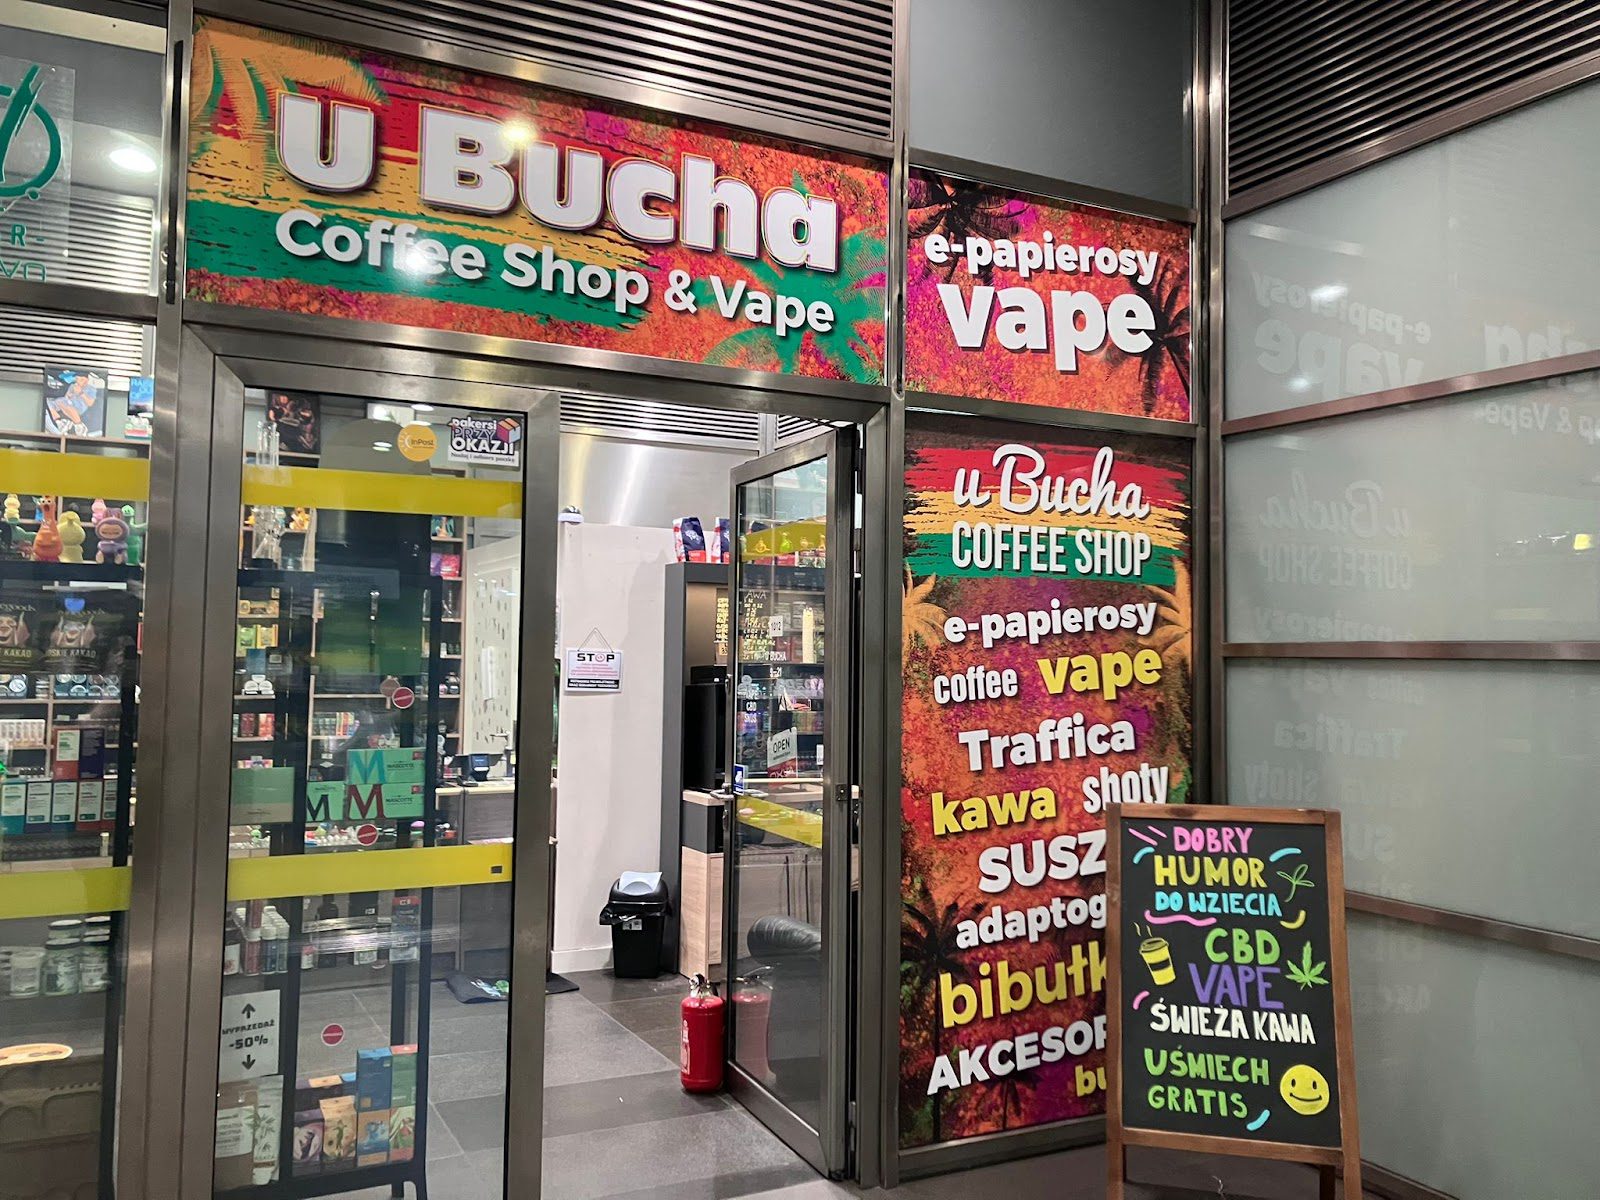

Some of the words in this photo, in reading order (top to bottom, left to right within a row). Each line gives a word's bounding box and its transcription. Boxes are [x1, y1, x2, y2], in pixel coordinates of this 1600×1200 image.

[275, 91, 377, 192] u
[419, 104, 839, 271] Bucha
[275, 209, 487, 281] Coffee
[502, 243, 649, 315] Shop
[664, 269, 697, 312] &
[708, 274, 835, 337] Vape
[924, 232, 1158, 286] e-papierosy
[937, 283, 1156, 371] vape
[452, 427, 496, 441] PRZY
[452, 437, 514, 455] OKAZJI
[954, 466, 990, 508] u
[992, 444, 1151, 518] Bucha
[951, 520, 1067, 573] COFFEE
[1075, 529, 1152, 576] SHOP
[943, 598, 1158, 648] e-papierosy
[933, 665, 1018, 704] coffee
[1037, 649, 1163, 700] vape
[772, 737, 791, 754] OPEN
[959, 712, 1136, 771] Traffica
[931, 785, 1057, 836] kawa
[1081, 763, 1169, 814] shoty
[978, 829, 1107, 893] SUSZ
[1173, 826, 1254, 854] DOBRY
[1153, 855, 1268, 888] HUMOR
[956, 893, 1107, 949] adaptog
[1155, 890, 1184, 912] DO
[1187, 891, 1283, 917] WZIĘCIA
[1204, 927, 1281, 965] CBD
[1187, 963, 1285, 1009] VAPE
[228, 1034, 269, 1050] -50%
[1149, 997, 1250, 1040] ŚWIEŻA
[1252, 1010, 1317, 1045] KAWA
[1143, 1044, 1270, 1086] UŚMIECH
[1148, 1084, 1249, 1119] GRATIS
